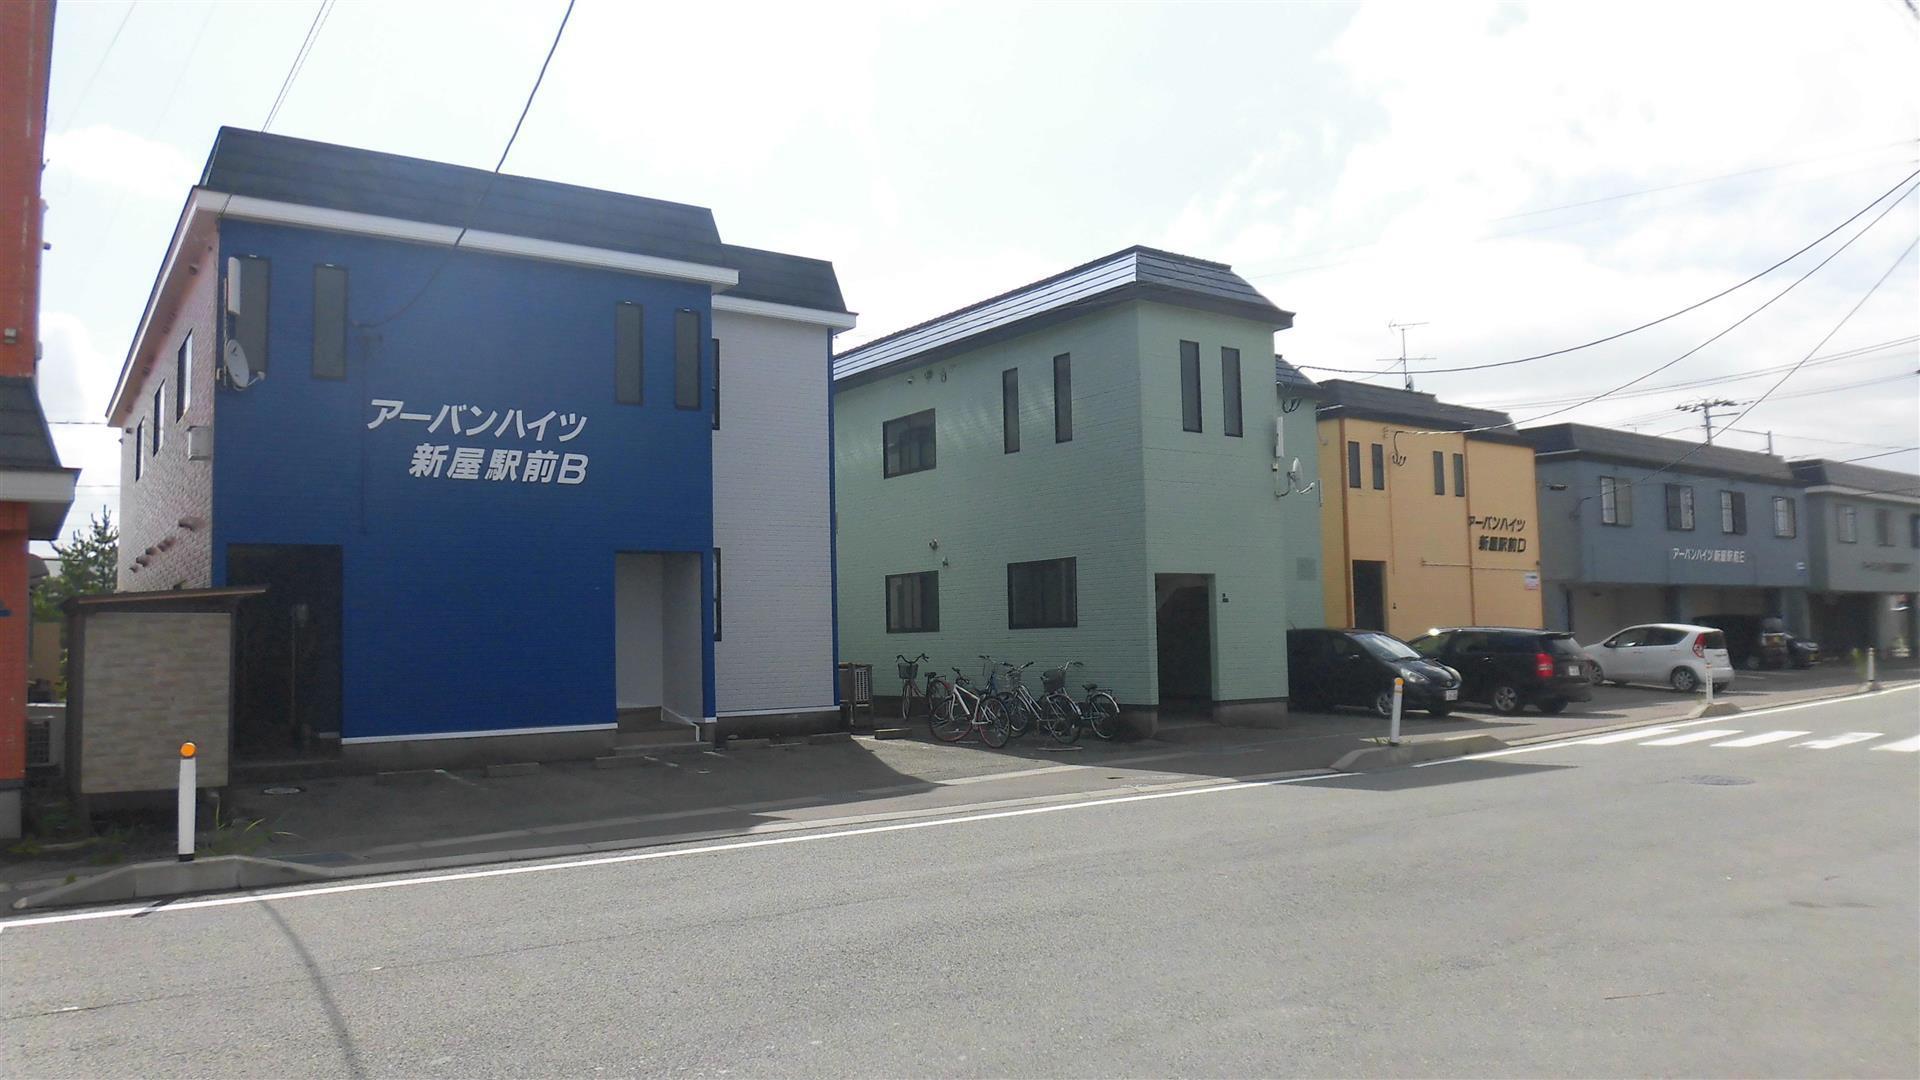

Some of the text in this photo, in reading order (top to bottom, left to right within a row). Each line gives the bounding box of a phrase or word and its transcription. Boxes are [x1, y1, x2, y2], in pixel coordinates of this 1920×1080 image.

[366, 399, 588, 442] アーバンハイツ
[408, 442, 590, 485] 新屋駅前B
[1468, 515, 1526, 532] アーバンハイツ
